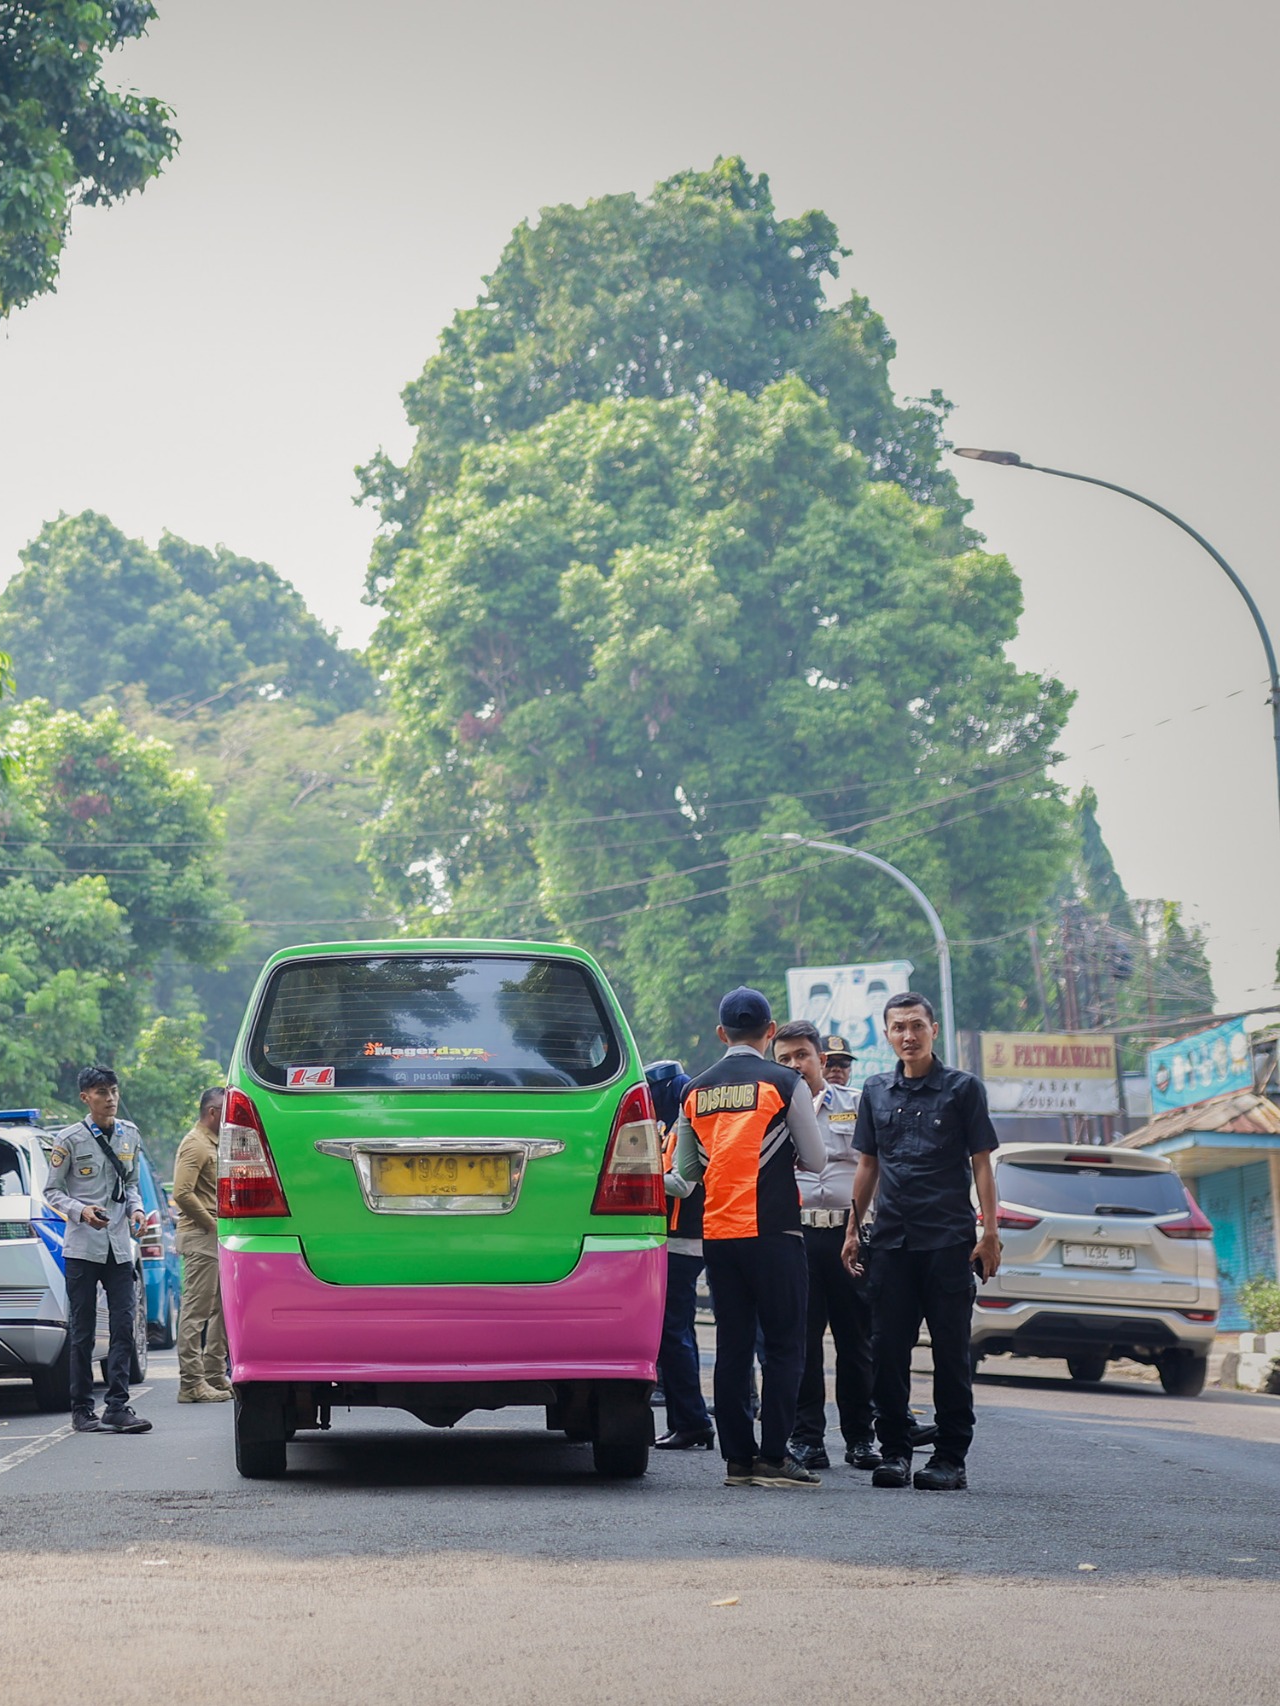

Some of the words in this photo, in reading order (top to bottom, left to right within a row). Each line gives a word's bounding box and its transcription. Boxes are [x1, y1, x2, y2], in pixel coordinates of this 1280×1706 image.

[1014, 1044, 1113, 1068] FATMAWATI
[289, 1068, 334, 1086] 14
[413, 1071, 450, 1082] pusaka
[697, 1084, 755, 1115] DISHUB
